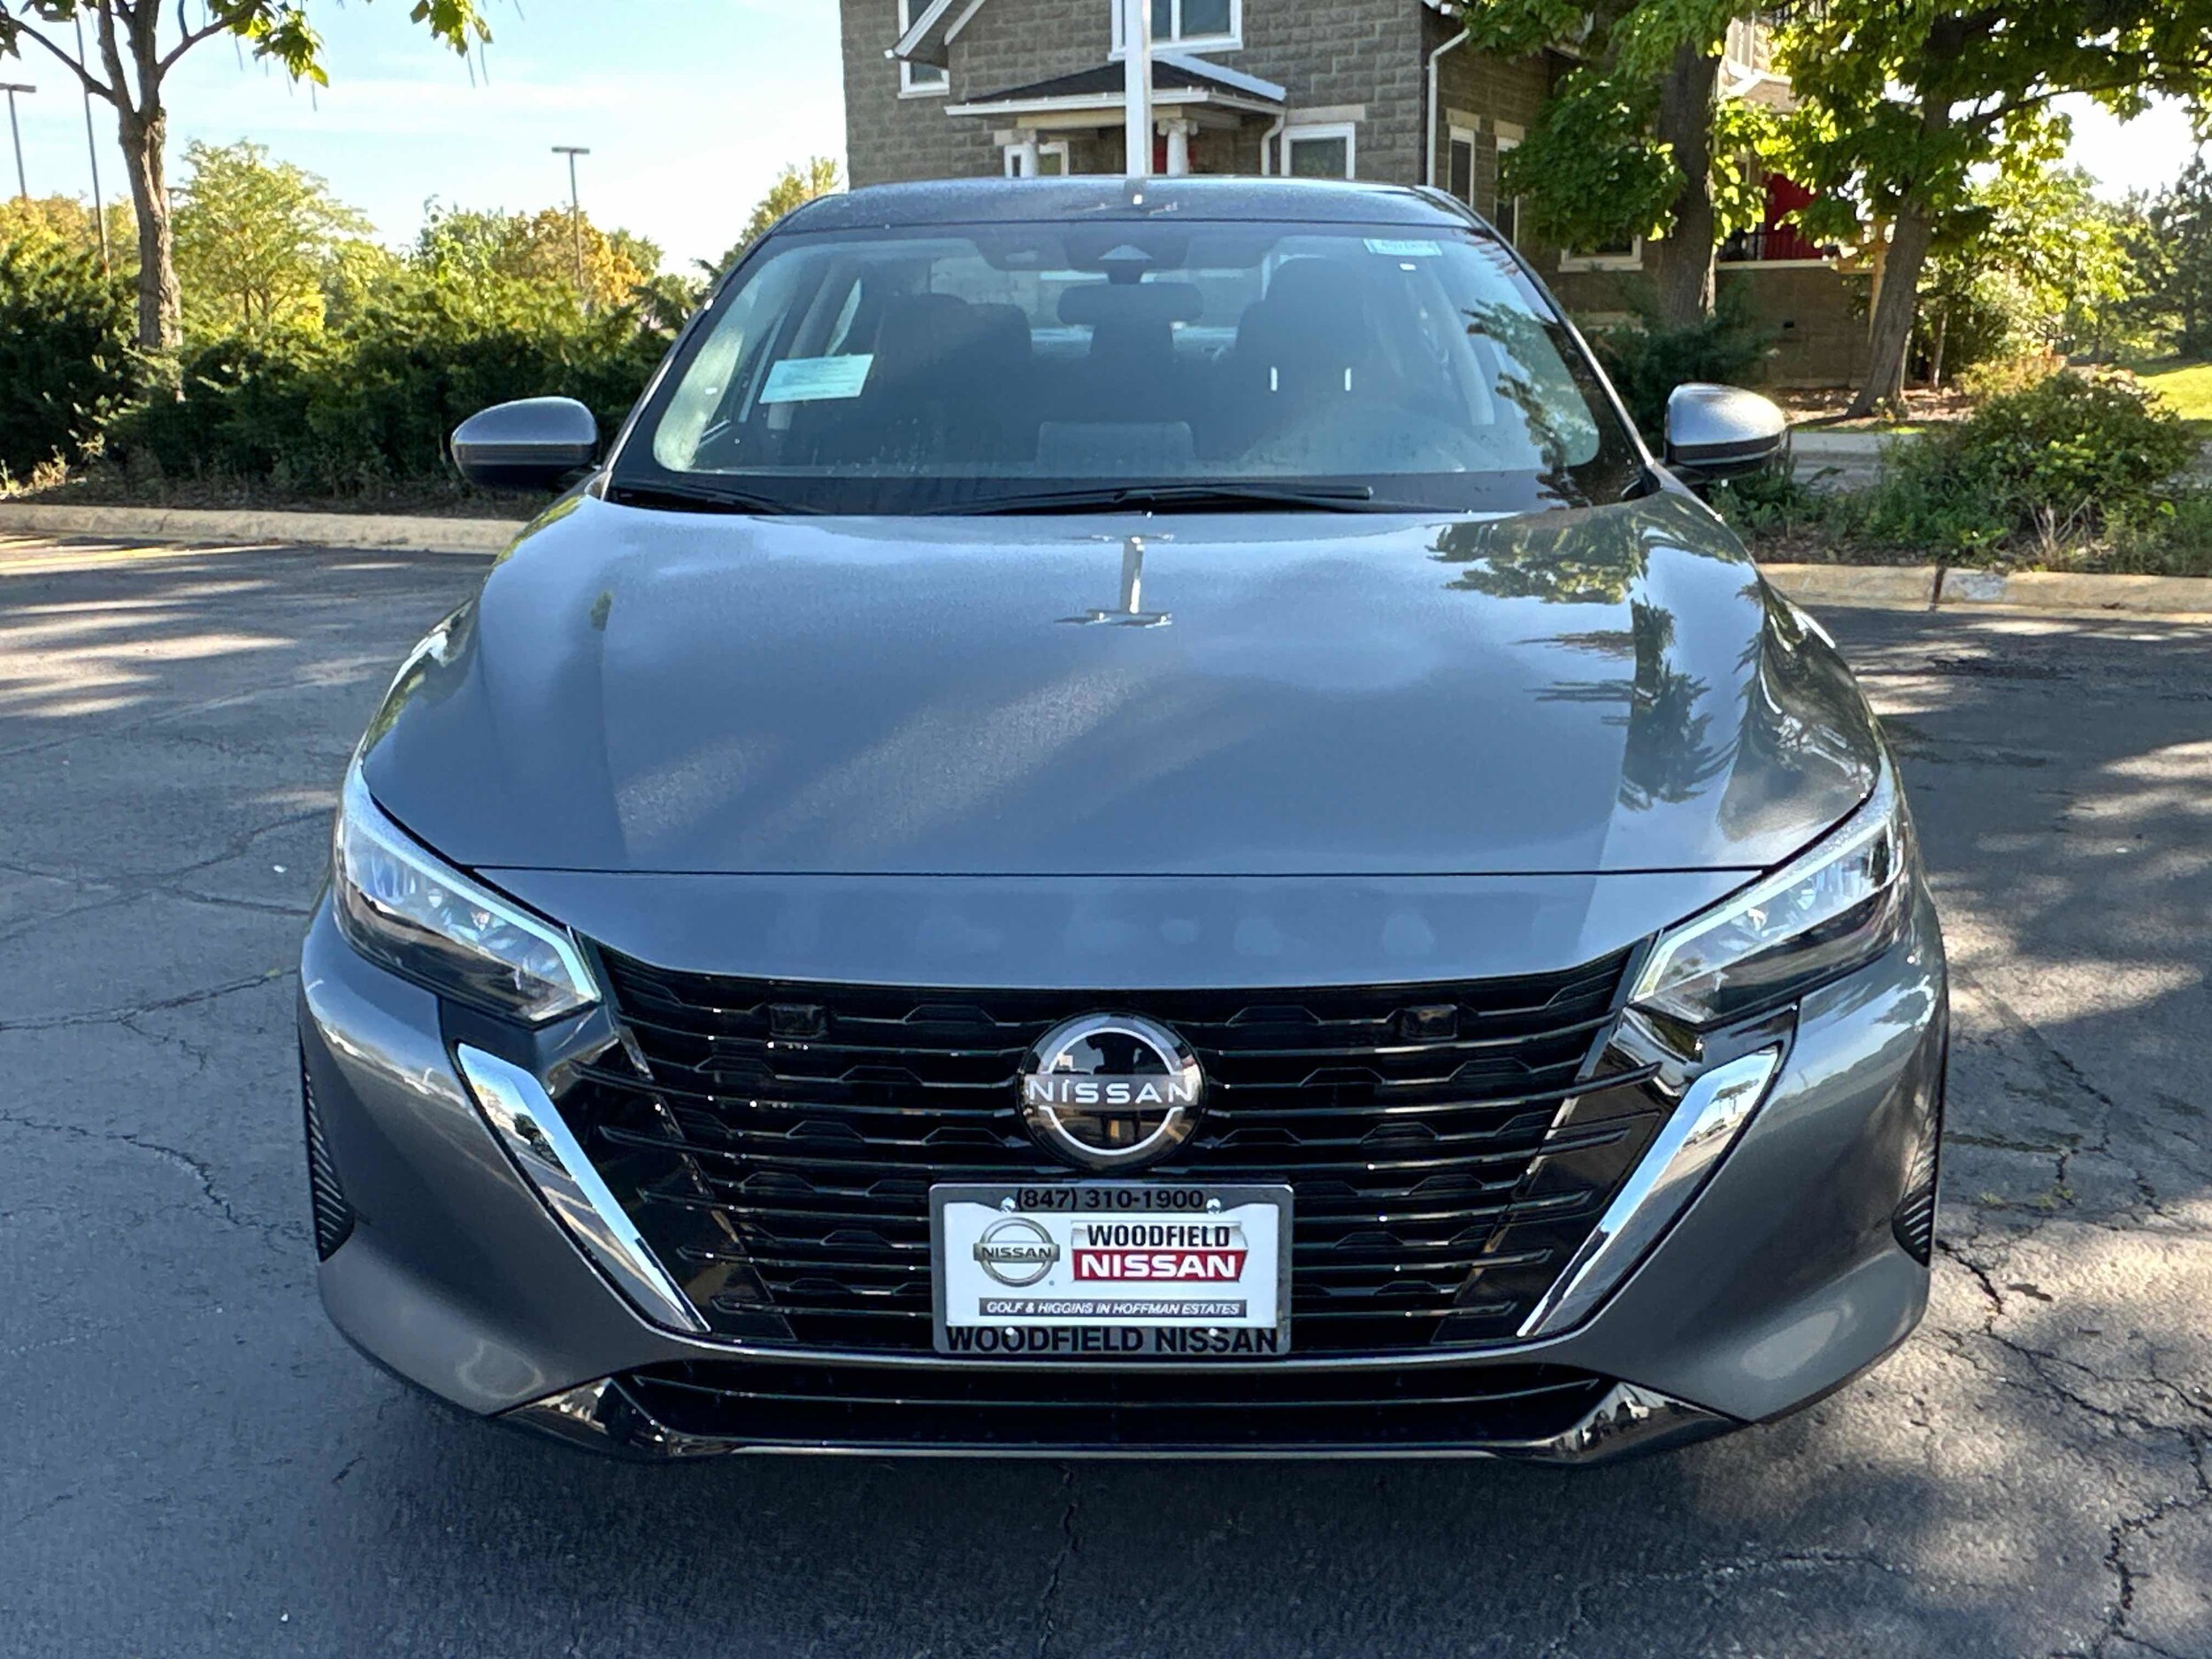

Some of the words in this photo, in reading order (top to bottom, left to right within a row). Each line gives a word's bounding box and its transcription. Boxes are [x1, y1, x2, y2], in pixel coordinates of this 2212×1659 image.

[1027, 1079, 1194, 1104] NISSAN
[1017, 1187, 1077, 1211] (847)
[1085, 1190, 1204, 1209] 310-1900
[1087, 1224, 1231, 1248] WOODFIELD
[981, 1247, 1052, 1259] NISSAN
[1080, 1253, 1236, 1279] NISSAN
[987, 1302, 1025, 1314] GOLF
[1025, 1302, 1034, 1314] &
[1038, 1302, 1094, 1315] HIGGINS
[1095, 1303, 1111, 1314] IN
[1112, 1303, 1179, 1315] HOFFMAN
[1181, 1303, 1240, 1316] ESTATES
[946, 1326, 1144, 1352] WOODFIELD
[1155, 1327, 1278, 1353] NISSAN
